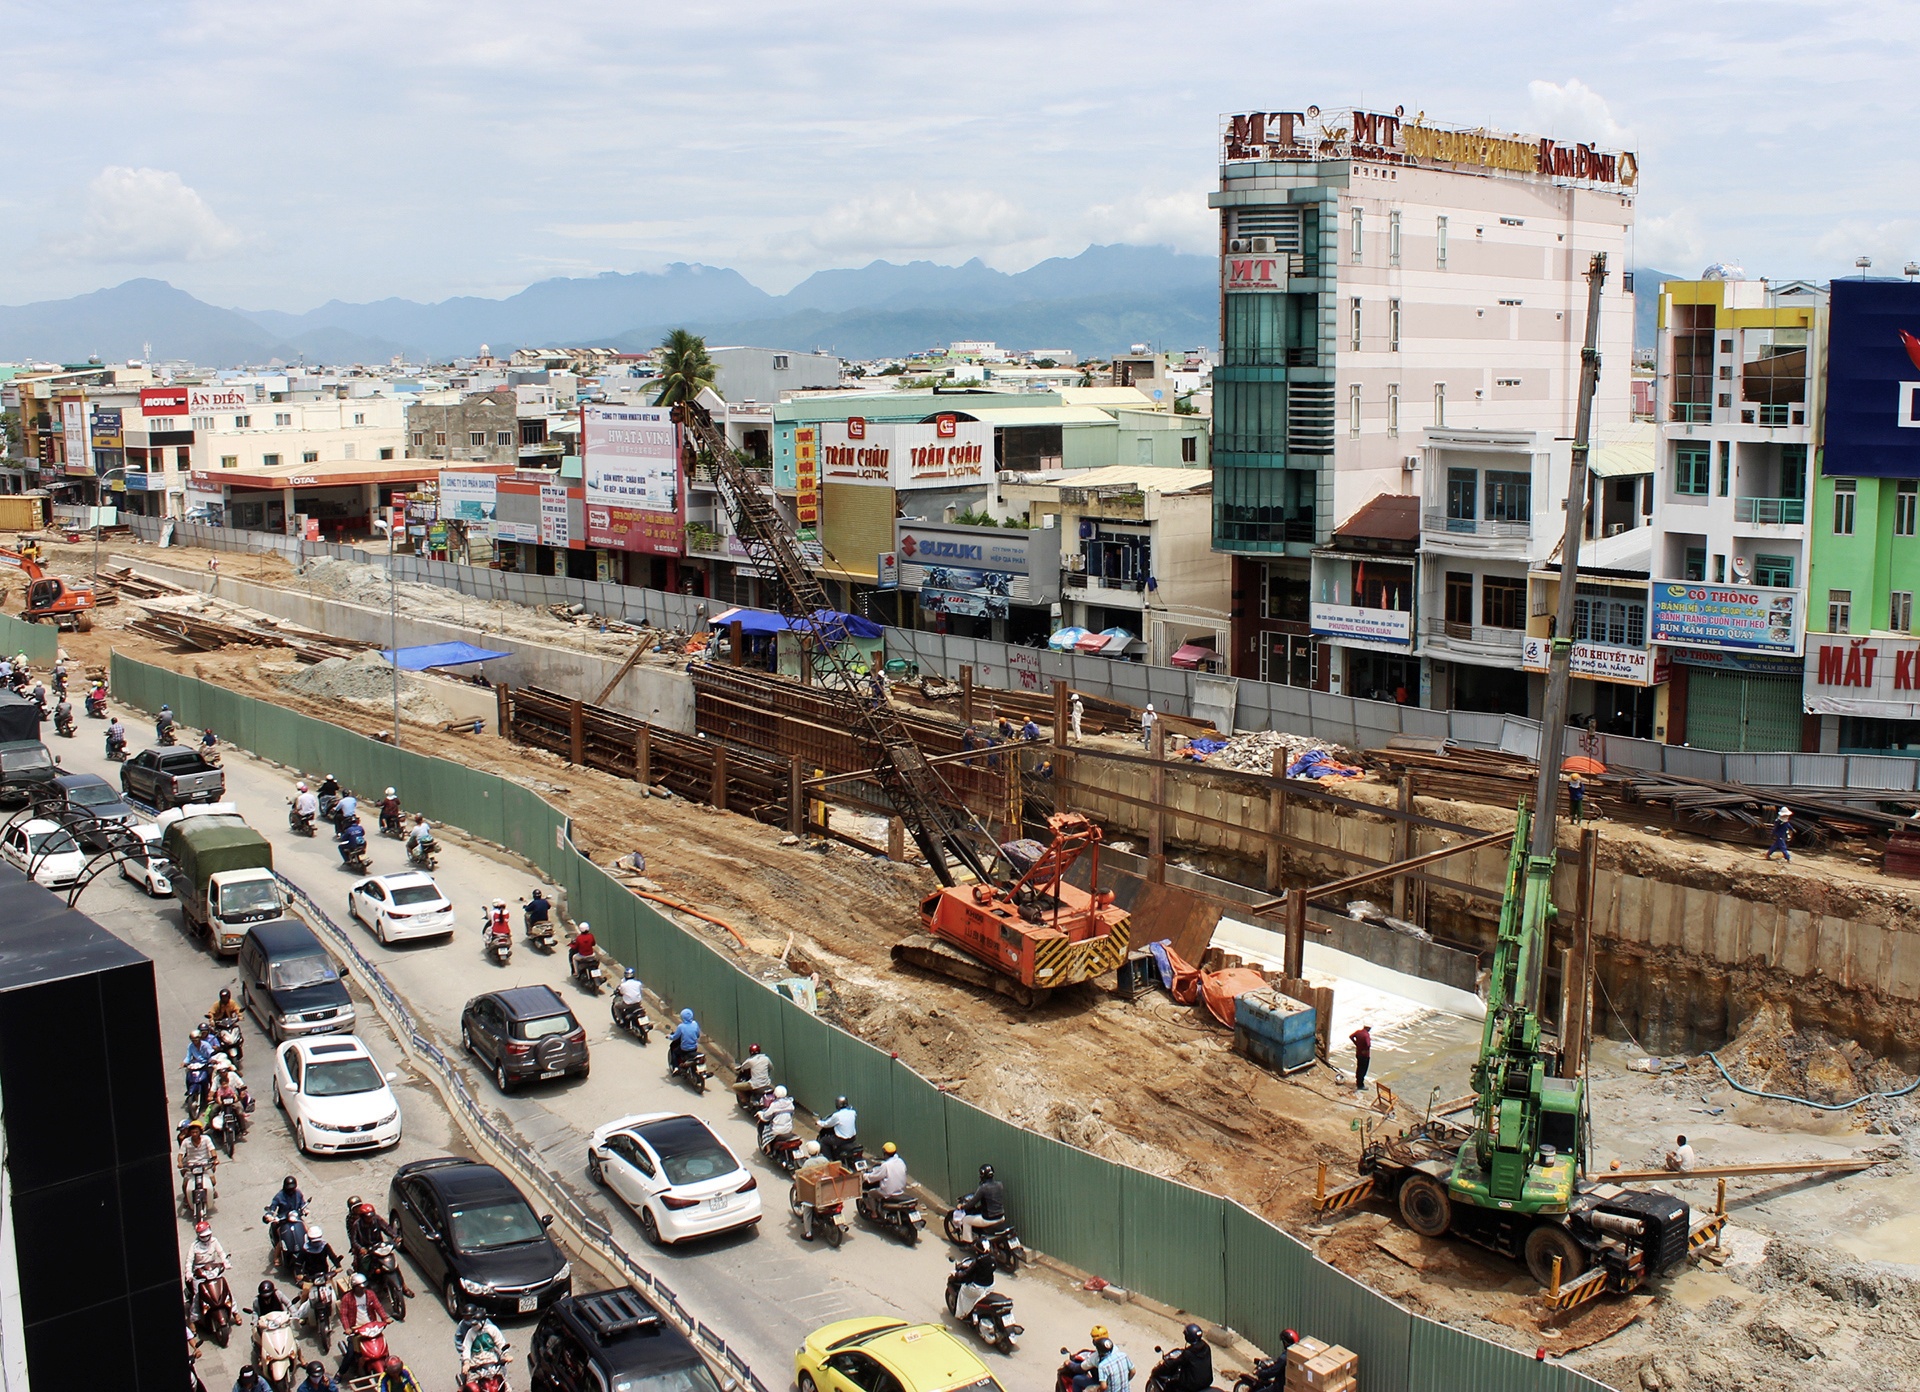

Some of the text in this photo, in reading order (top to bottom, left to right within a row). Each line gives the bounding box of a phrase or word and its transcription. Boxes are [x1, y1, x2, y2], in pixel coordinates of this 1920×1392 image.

[1229, 112, 1305, 147] MT
[1230, 259, 1277, 282] MT
[144, 398, 176, 407] MOTUL
[608, 430, 644, 444] HWATA
[646, 432, 671, 446] VINA
[825, 442, 889, 468] TRÂN CHÂU
[911, 441, 982, 467] TRÂN CHÂU
[920, 540, 982, 560] SUZUKI
[1688, 588, 1759, 604] CÔ THÔNG
[1660, 602, 1685, 611] BÁNH
[1660, 612, 1680, 621] BÁNH
[1750, 620, 1765, 629] HEO
[1660, 622, 1755, 639] BÚN MẮM HEO QUAY
[1582, 660, 1596, 668] PHỐ
[1590, 648, 1627, 663] KHUYẾT
[1629, 653, 1646, 666] TẬT
[1690, 650, 1723, 662] THÔNG
[1818, 638, 1878, 688] MẮT
